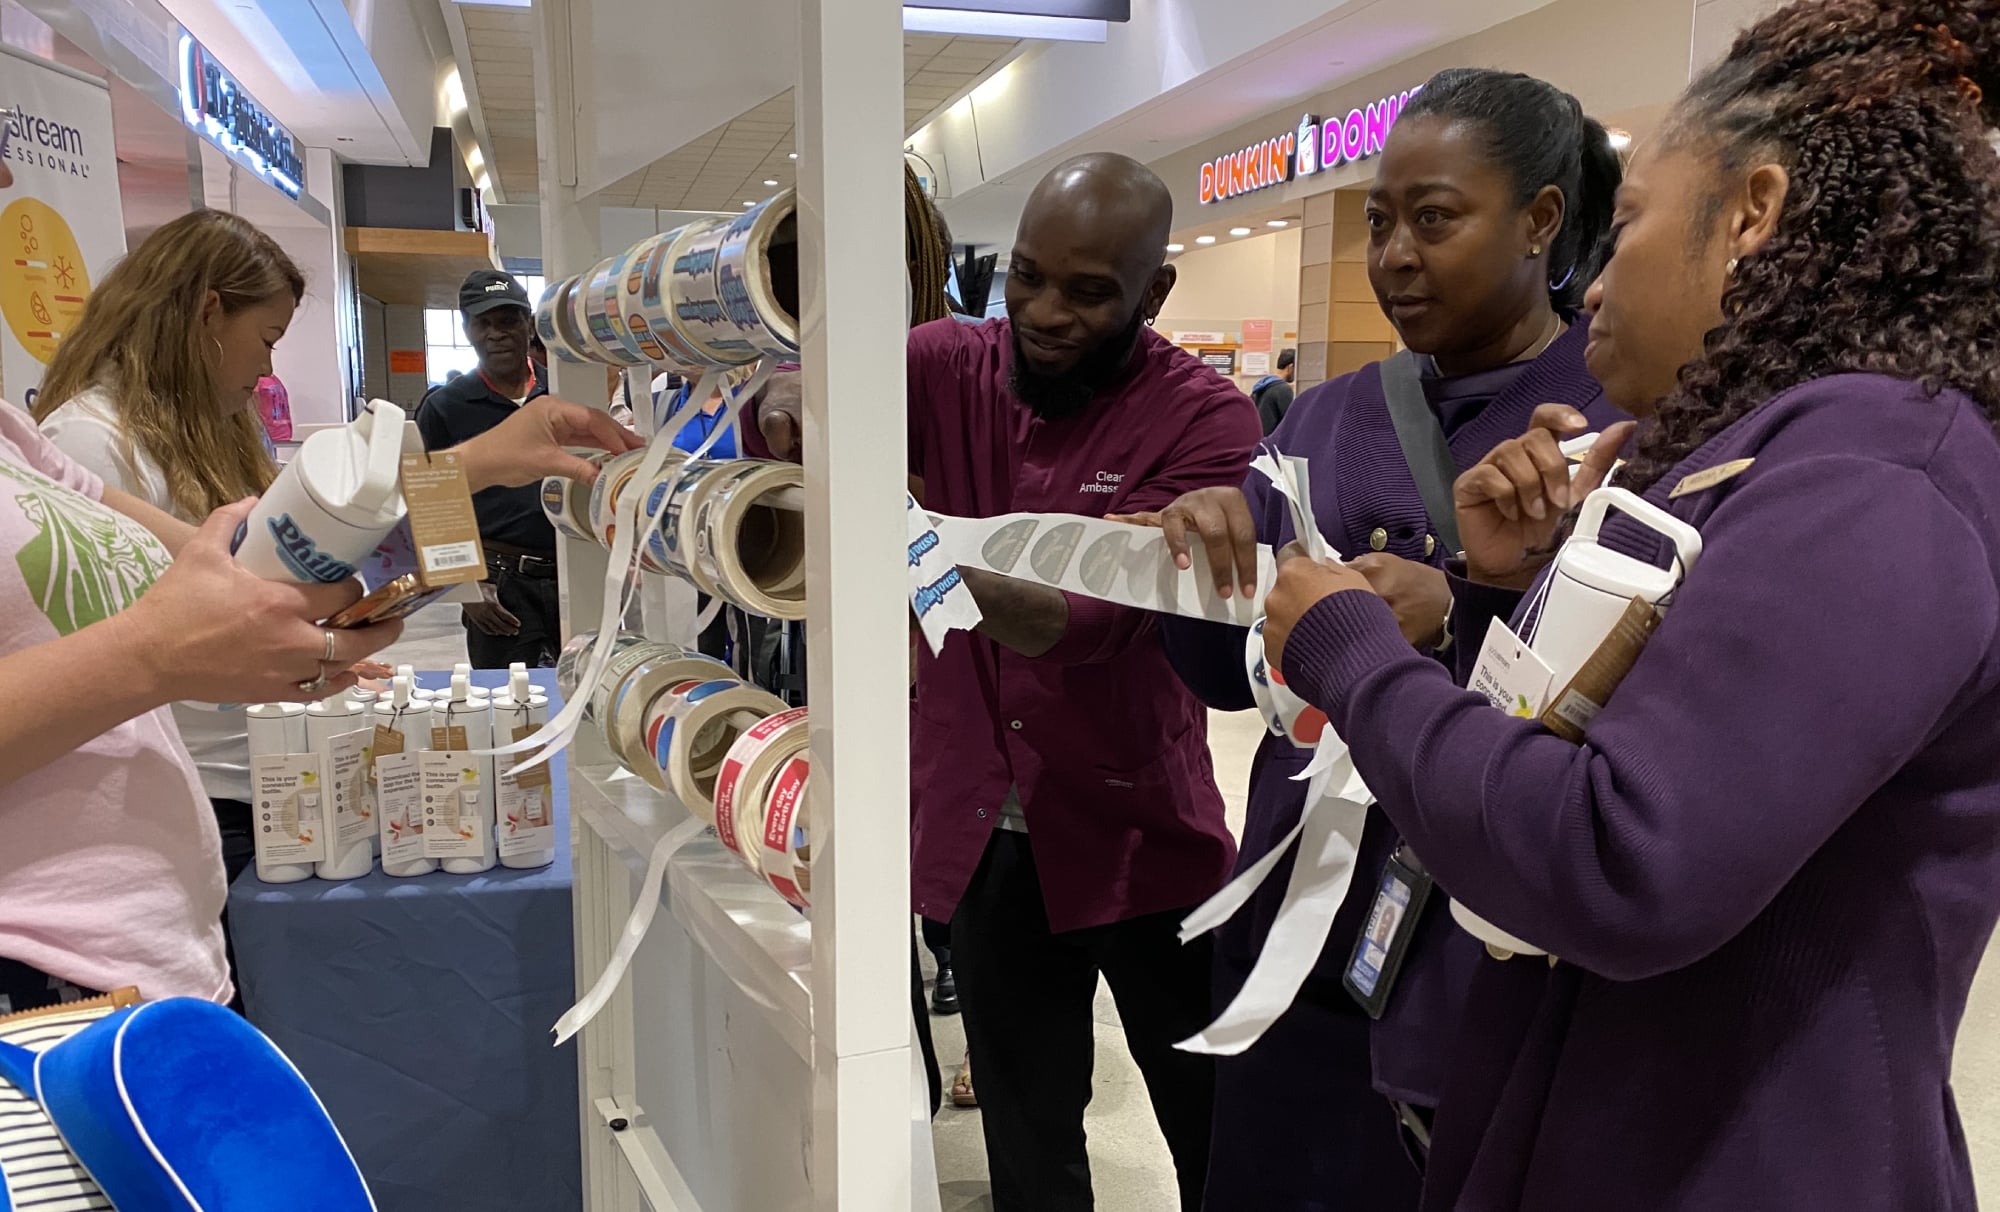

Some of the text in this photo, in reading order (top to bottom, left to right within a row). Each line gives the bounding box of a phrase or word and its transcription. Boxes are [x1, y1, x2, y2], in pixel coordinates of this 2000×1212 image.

[1200, 131, 1295, 205] DUNKIN'
[1096, 471, 1125, 482] Clear
[768, 787, 788, 841] Every day
[777, 802, 791, 832] Earth
[786, 778, 801, 800] Day
